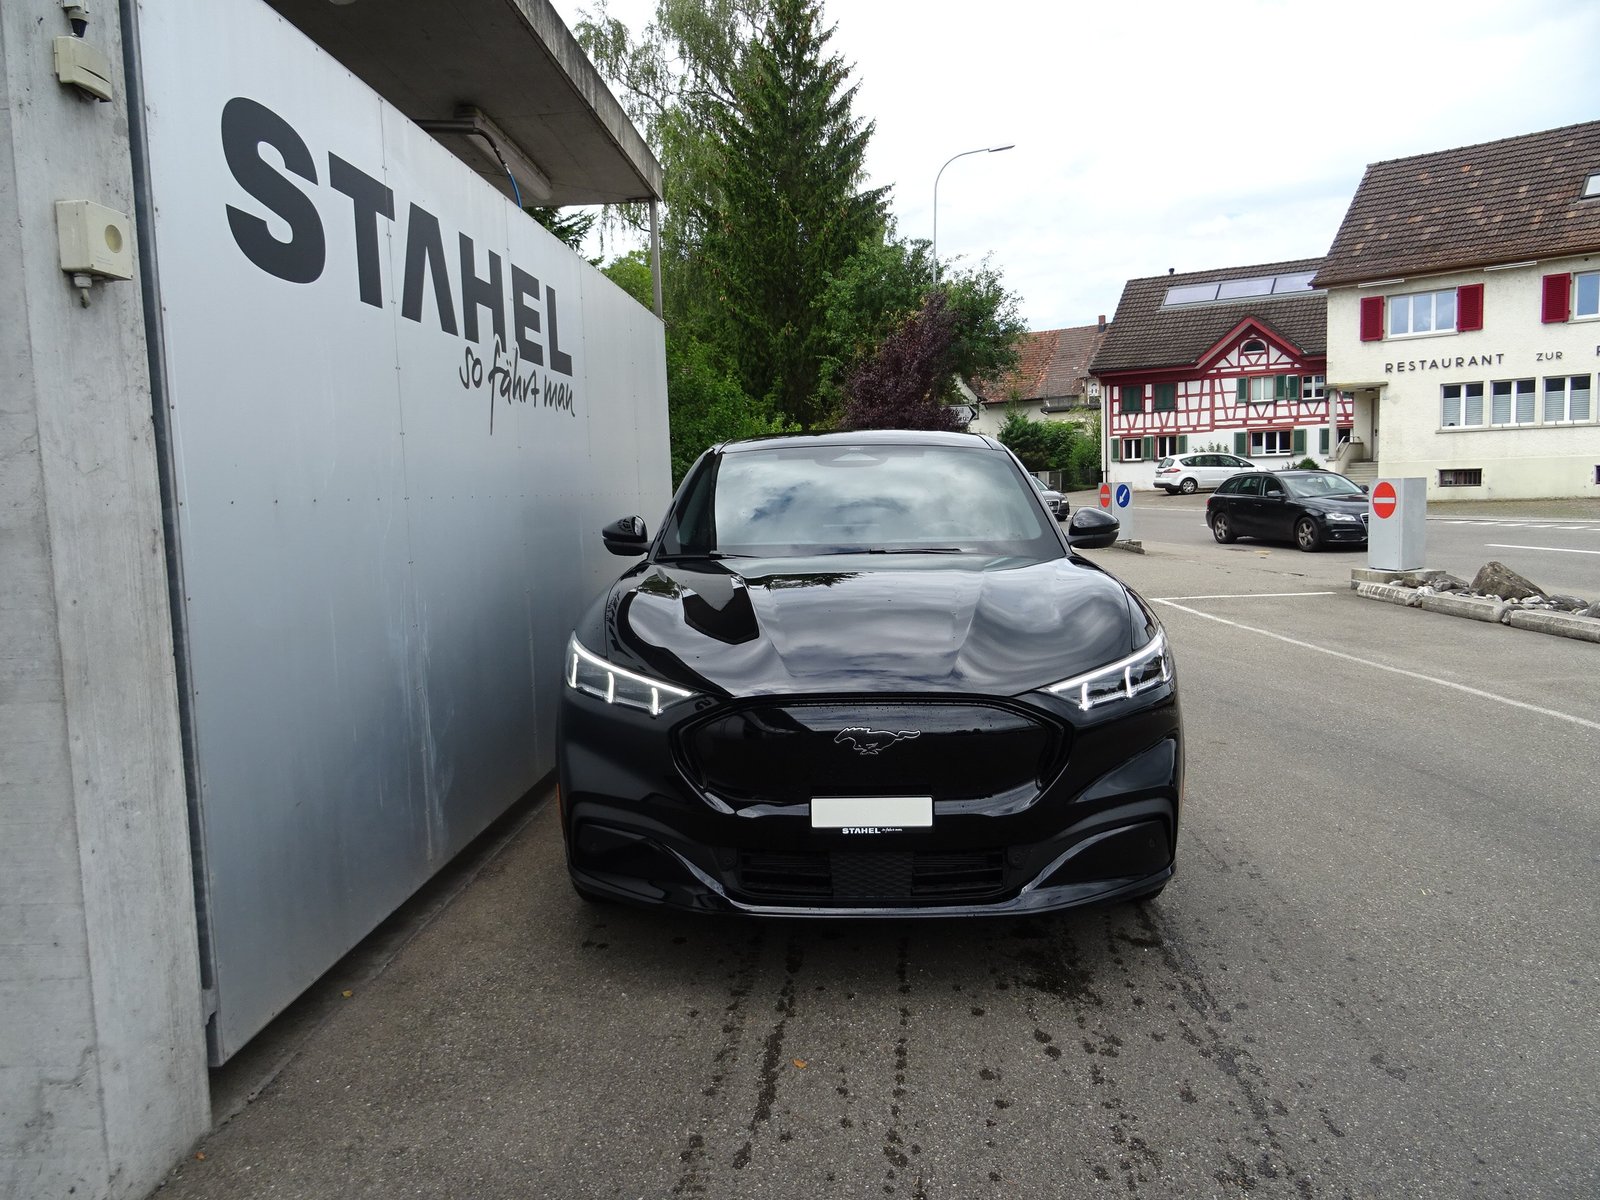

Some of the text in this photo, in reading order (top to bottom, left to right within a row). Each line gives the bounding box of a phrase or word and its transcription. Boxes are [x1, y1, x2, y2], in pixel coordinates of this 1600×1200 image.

[221, 97, 573, 377] STAHEL
[488, 339, 540, 436] fährt
[544, 374, 575, 418] man
[1385, 351, 1563, 373] RESTAURANT ZUR
